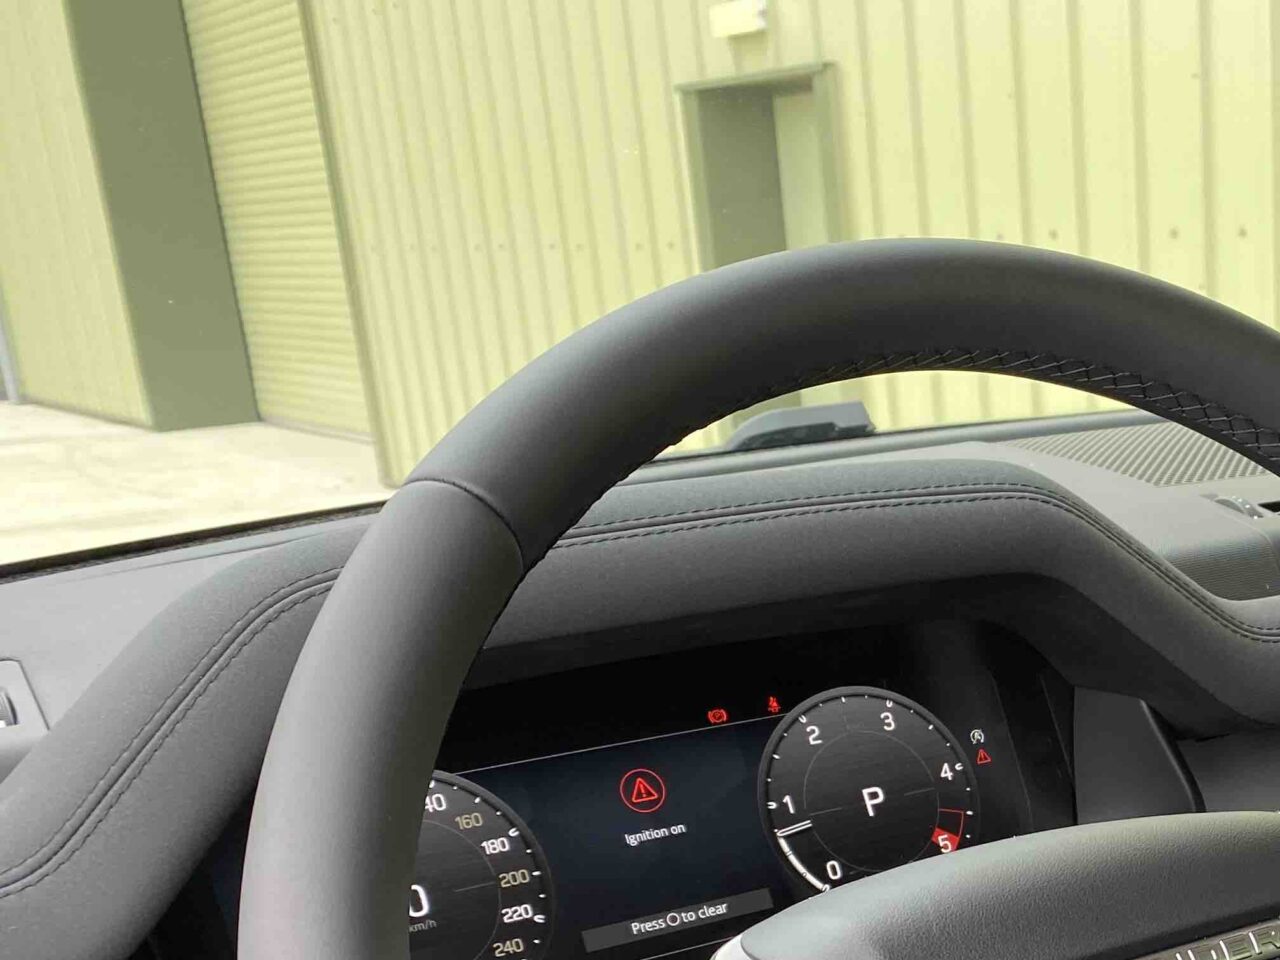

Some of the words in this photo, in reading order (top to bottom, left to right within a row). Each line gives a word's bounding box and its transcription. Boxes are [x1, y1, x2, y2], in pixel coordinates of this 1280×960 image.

[880, 712, 895, 731] 3
[806, 725, 822, 745] 2
[940, 763, 953, 780] 4
[424, 793, 447, 812] 40
[782, 794, 795, 814] 1
[861, 786, 884, 816] P
[454, 812, 483, 830] 160
[624, 826, 668, 847] Ignition
[669, 823, 687, 836] on
[937, 834, 951, 853] 5
[480, 837, 510, 855] 180
[498, 868, 530, 887] 200
[826, 860, 842, 880] 0
[502, 904, 533, 922] 220
[630, 917, 666, 935] Press
[680, 911, 695, 922] to
[697, 902, 728, 919] clear
[493, 939, 525, 957] 240
